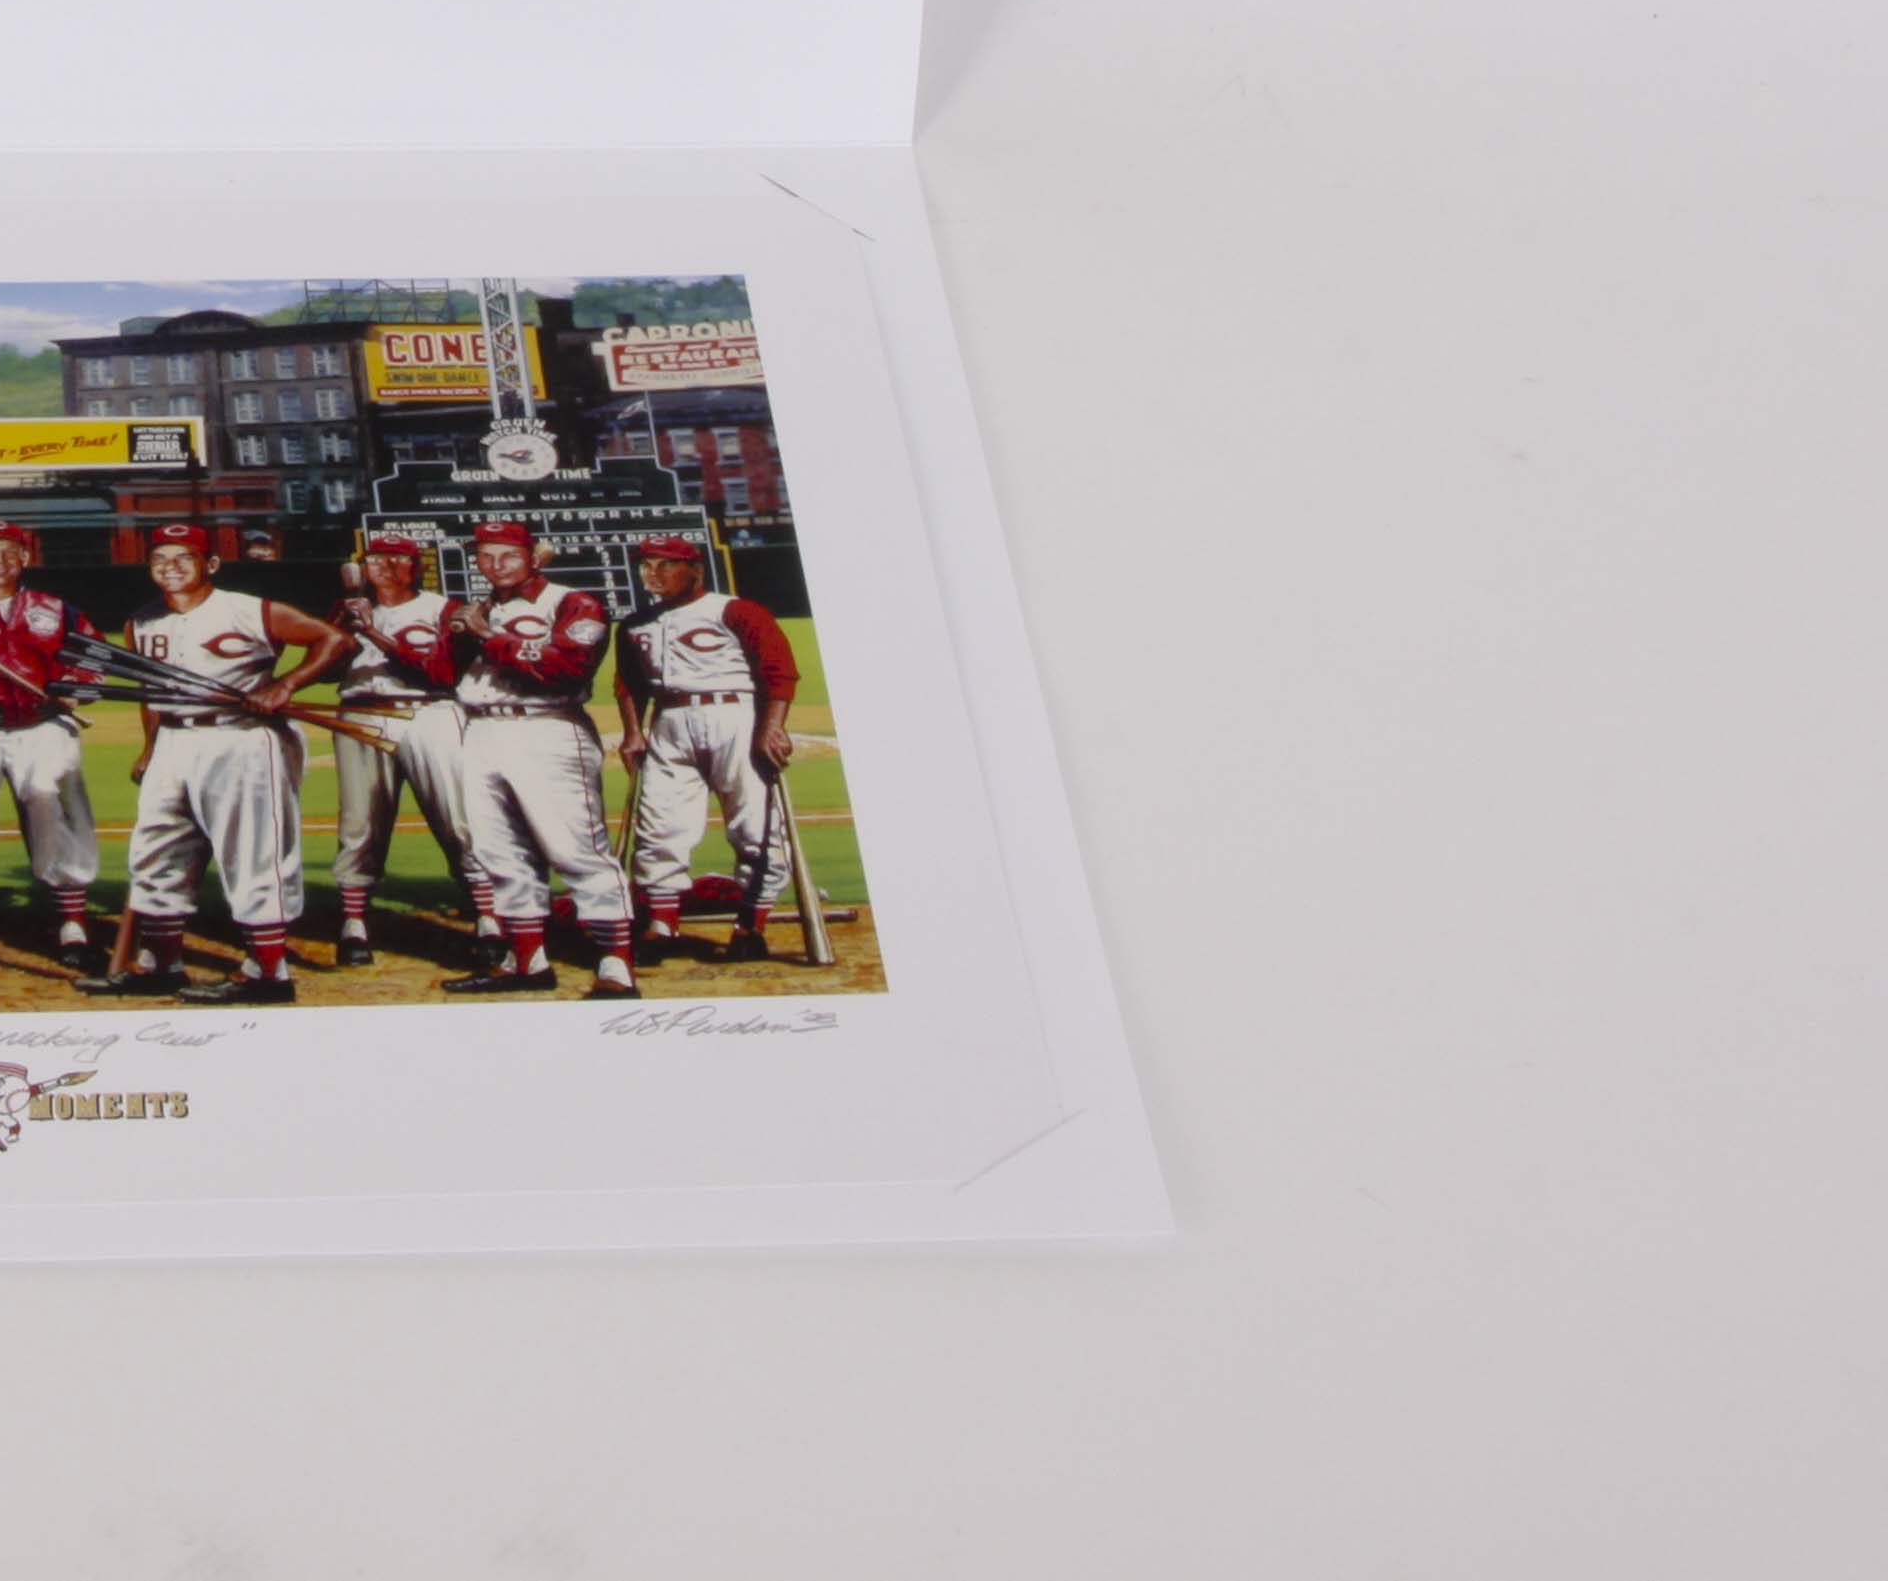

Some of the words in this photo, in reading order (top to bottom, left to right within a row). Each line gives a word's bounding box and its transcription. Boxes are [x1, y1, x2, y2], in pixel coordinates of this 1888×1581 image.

[525, 427, 559, 445] TIME
[450, 470, 501, 483] GRUEN
[551, 467, 593, 480] TIME
[138, 634, 170, 661] 18
[26, 1091, 190, 1121] MOMENTS
